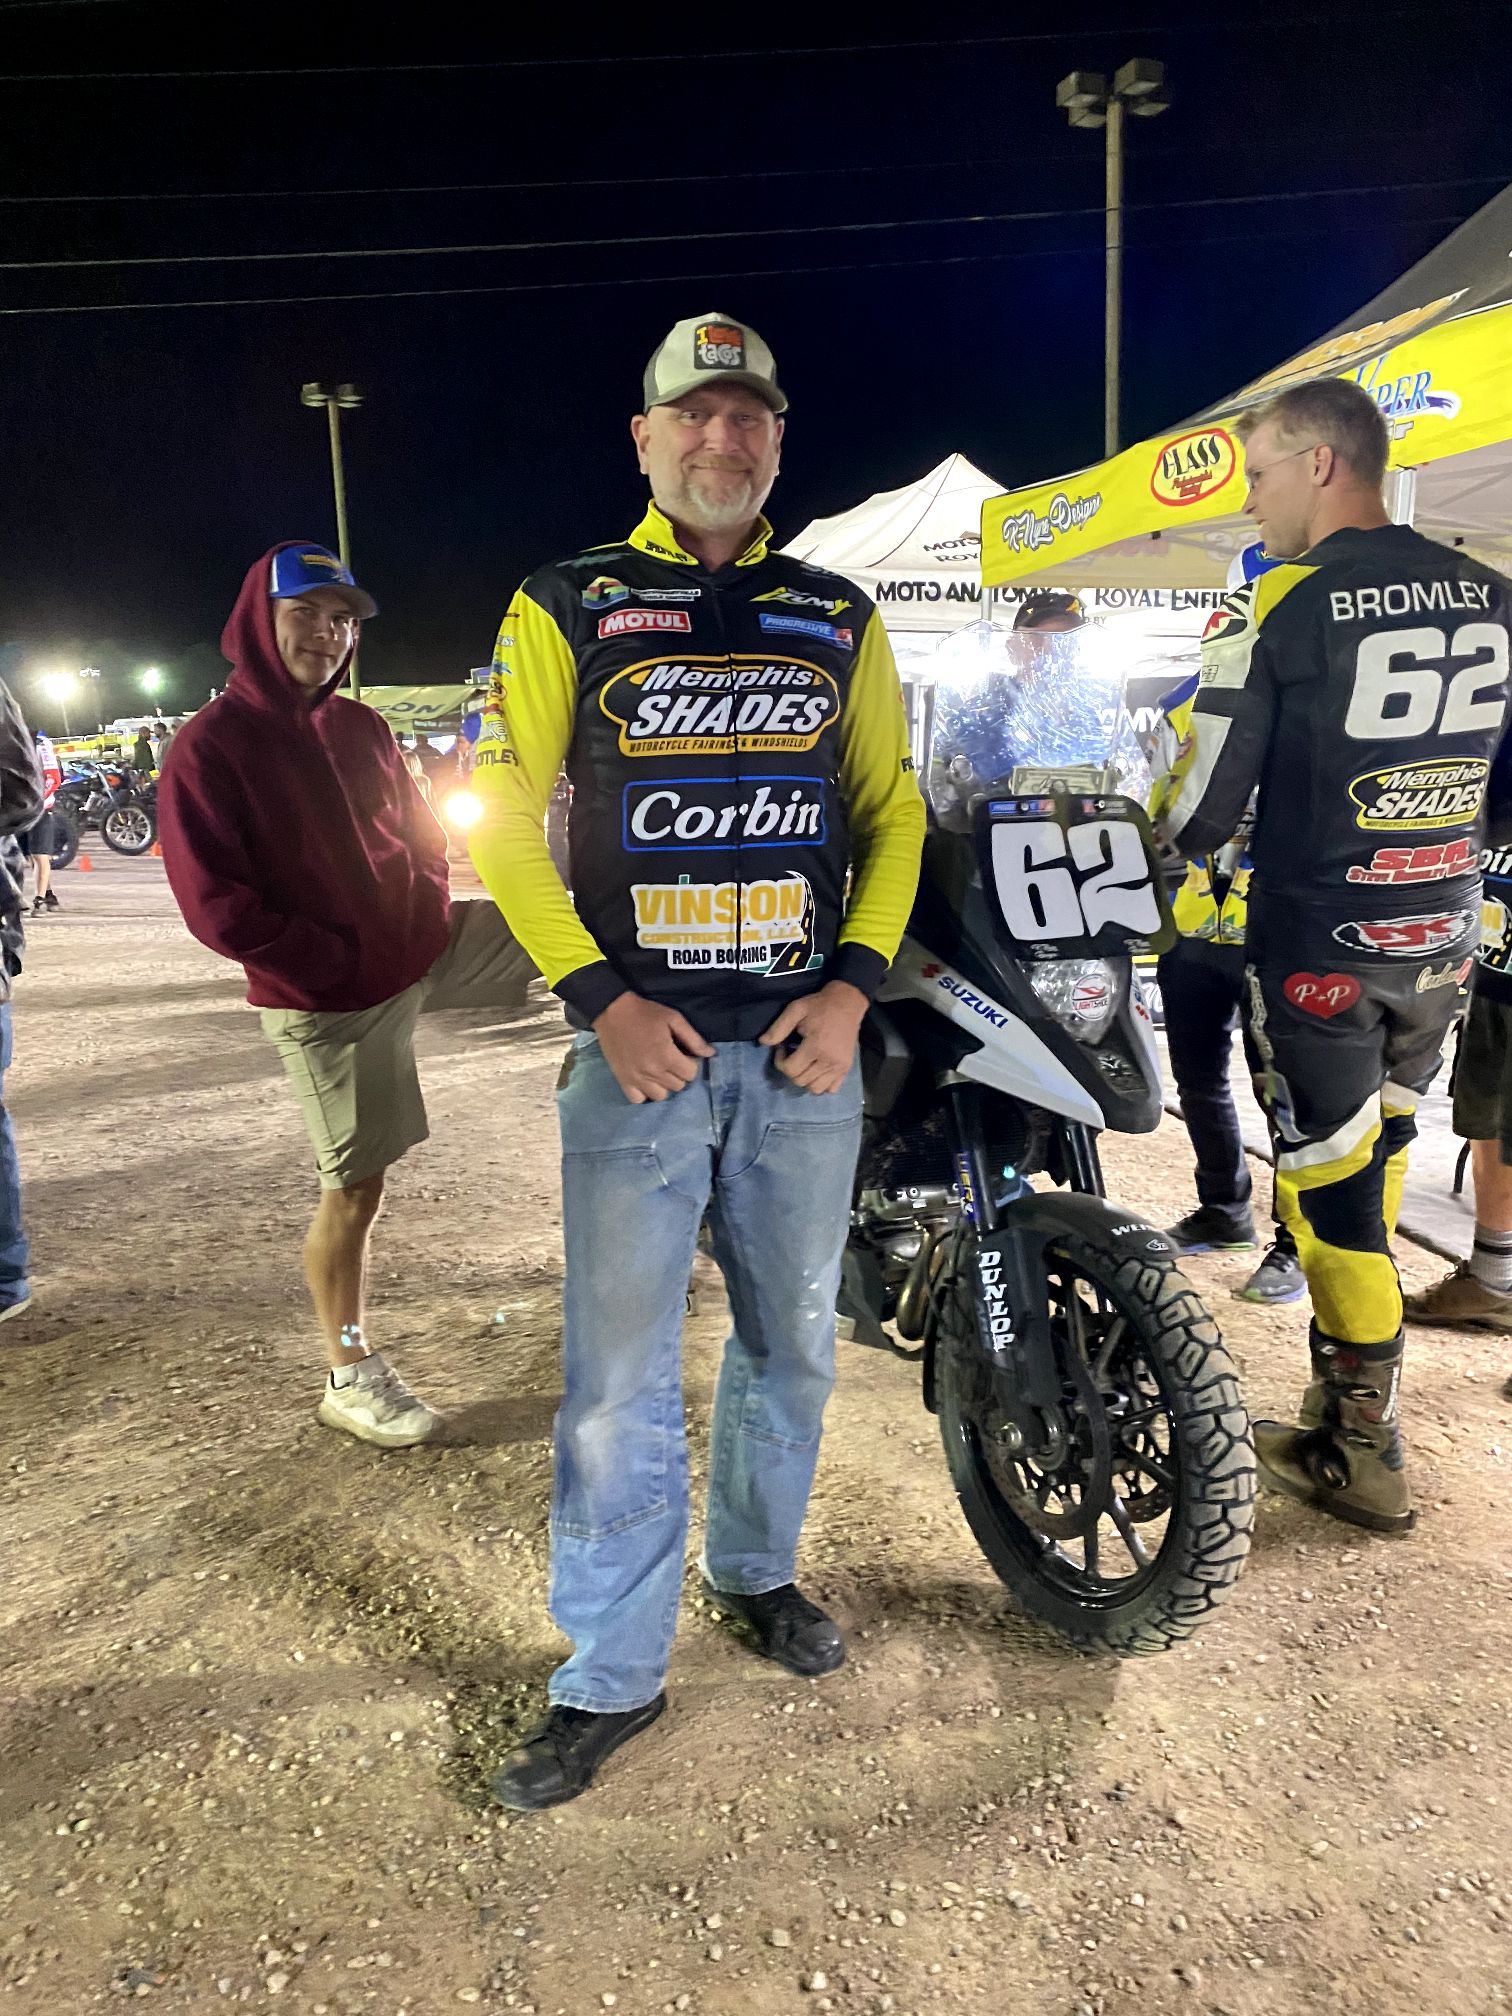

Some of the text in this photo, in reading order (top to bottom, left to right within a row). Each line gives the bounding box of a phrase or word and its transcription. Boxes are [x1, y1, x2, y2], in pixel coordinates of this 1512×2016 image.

[1162, 435, 1221, 479] GLASS
[1095, 587, 1166, 609] ROYAL
[1330, 580, 1490, 621] BROMLEY
[604, 613, 686, 633] MOTUL
[641, 665, 812, 691] Memphis
[1344, 622, 1510, 739] 62
[629, 693, 829, 737] SHADES
[629, 740, 688, 752] MOTORCYCLE
[751, 737, 807, 748] WINDSHIELDS
[1382, 762, 1487, 790] Memphis
[631, 786, 820, 841] Corbin
[1367, 781, 1485, 819] SHADES
[1372, 840, 1470, 870] SBR
[991, 821, 1161, 941] 62
[635, 883, 803, 925] VINSON
[673, 949, 711, 965] ROAD
[938, 975, 1008, 1028] SUZUKI
[979, 1251, 1016, 1353] DUNLOP
